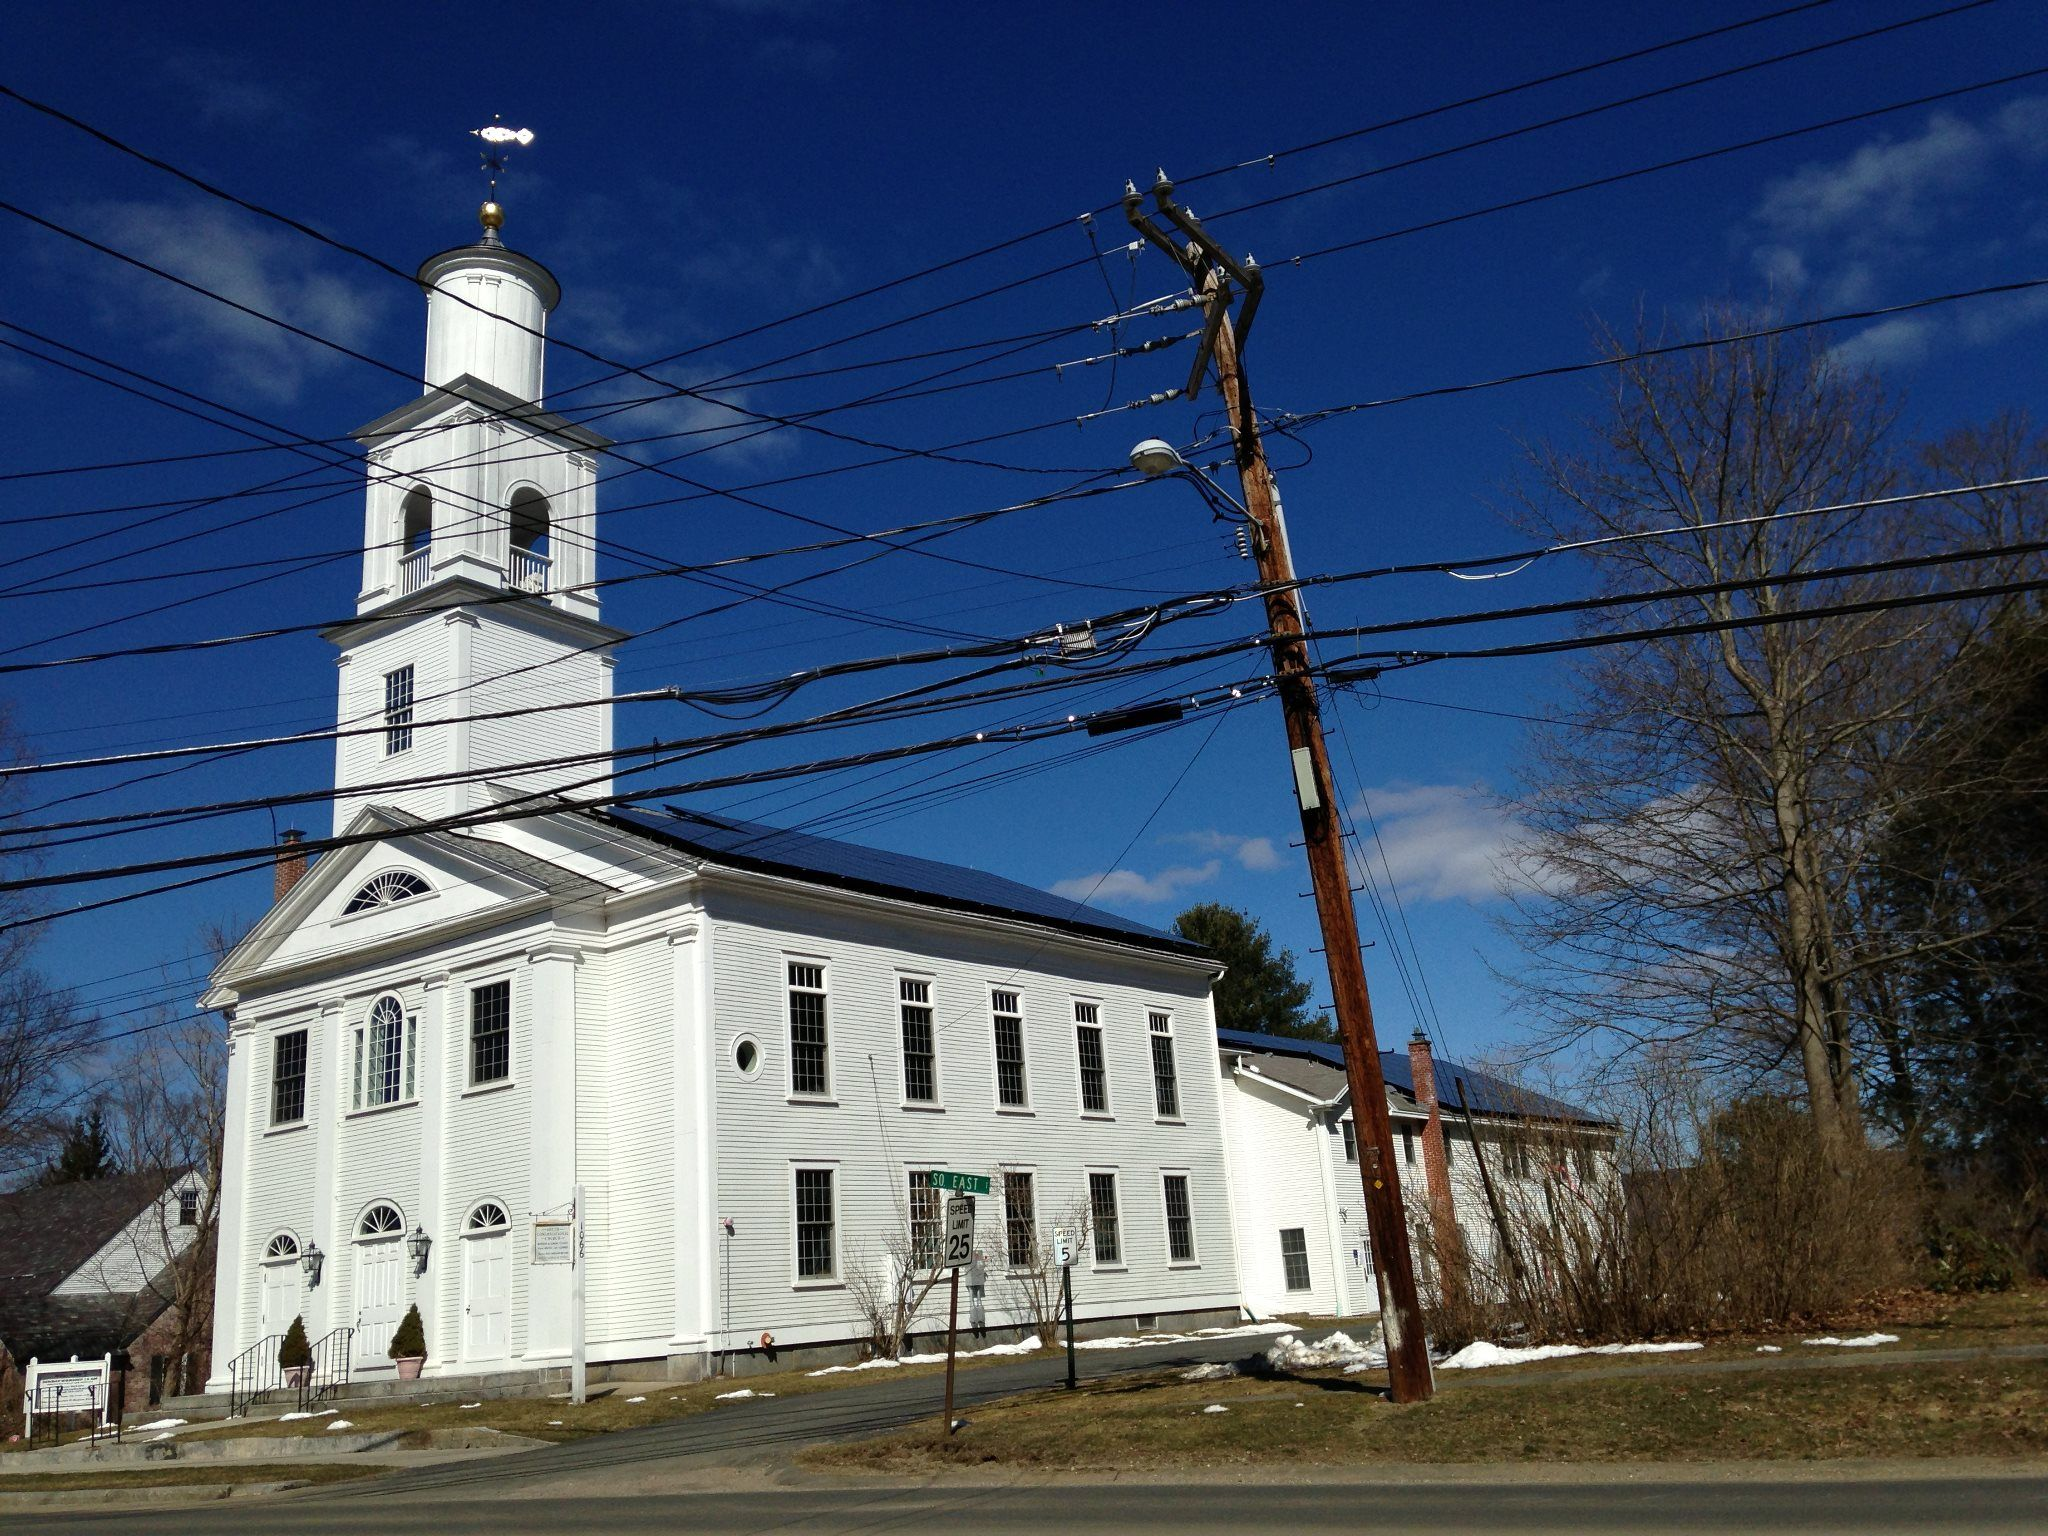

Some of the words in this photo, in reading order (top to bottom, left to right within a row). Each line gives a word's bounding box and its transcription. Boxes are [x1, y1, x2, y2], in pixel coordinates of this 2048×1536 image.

[952, 1175, 978, 1191] EAST
[952, 1218, 969, 1230] LIMIT
[1054, 1229, 1075, 1237] SPEED
[949, 1234, 970, 1260] 25
[1056, 1237, 1073, 1245] LIMIT
[1062, 1247, 1070, 1261] 5
